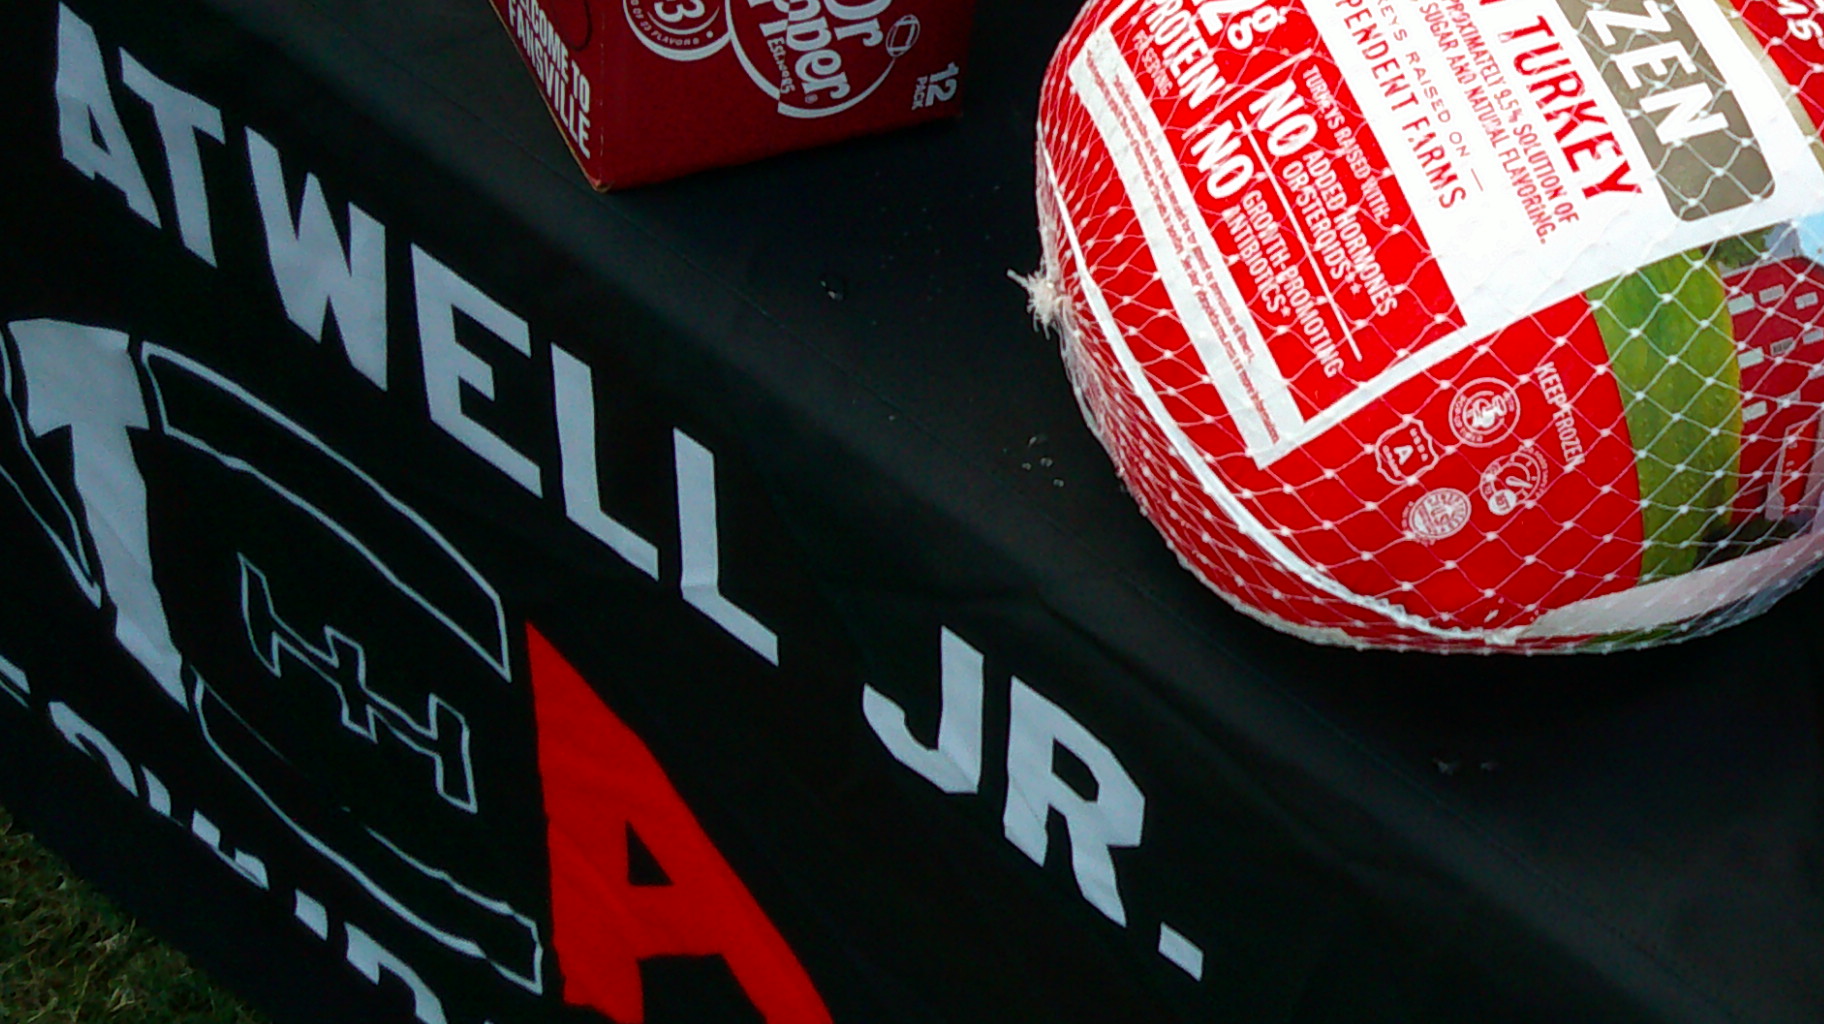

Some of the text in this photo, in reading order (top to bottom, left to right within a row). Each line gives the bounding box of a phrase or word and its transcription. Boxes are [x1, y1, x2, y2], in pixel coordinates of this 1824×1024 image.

[571, 59, 592, 115] TO
[911, 75, 928, 110] PACK
[923, 61, 961, 107] 12
[1248, 78, 1319, 157] NO
[1302, 64, 1372, 179] TURKEYS RAISED
[1405, 51, 1452, 125] RAISED
[1449, 131, 1471, 158] ON
[1419, 1, 1557, 245] SUGAR FLAVORING.
[1498, 14, 1643, 200] TURKEY
[1190, 119, 1255, 200] NO
[1282, 161, 1305, 193] OR
[1402, 119, 1468, 210] FARMS
[1513, 123, 1580, 225] SOLUTION OF
[1242, 189, 1345, 378] GROWTH-PROMOTING
[1302, 149, 1399, 317] ADDED HORMONES
[1534, 360, 1586, 473] KEEP FROZEN
[55, 0, 779, 667] ATWELL
[862, 625, 1203, 981] JR.
